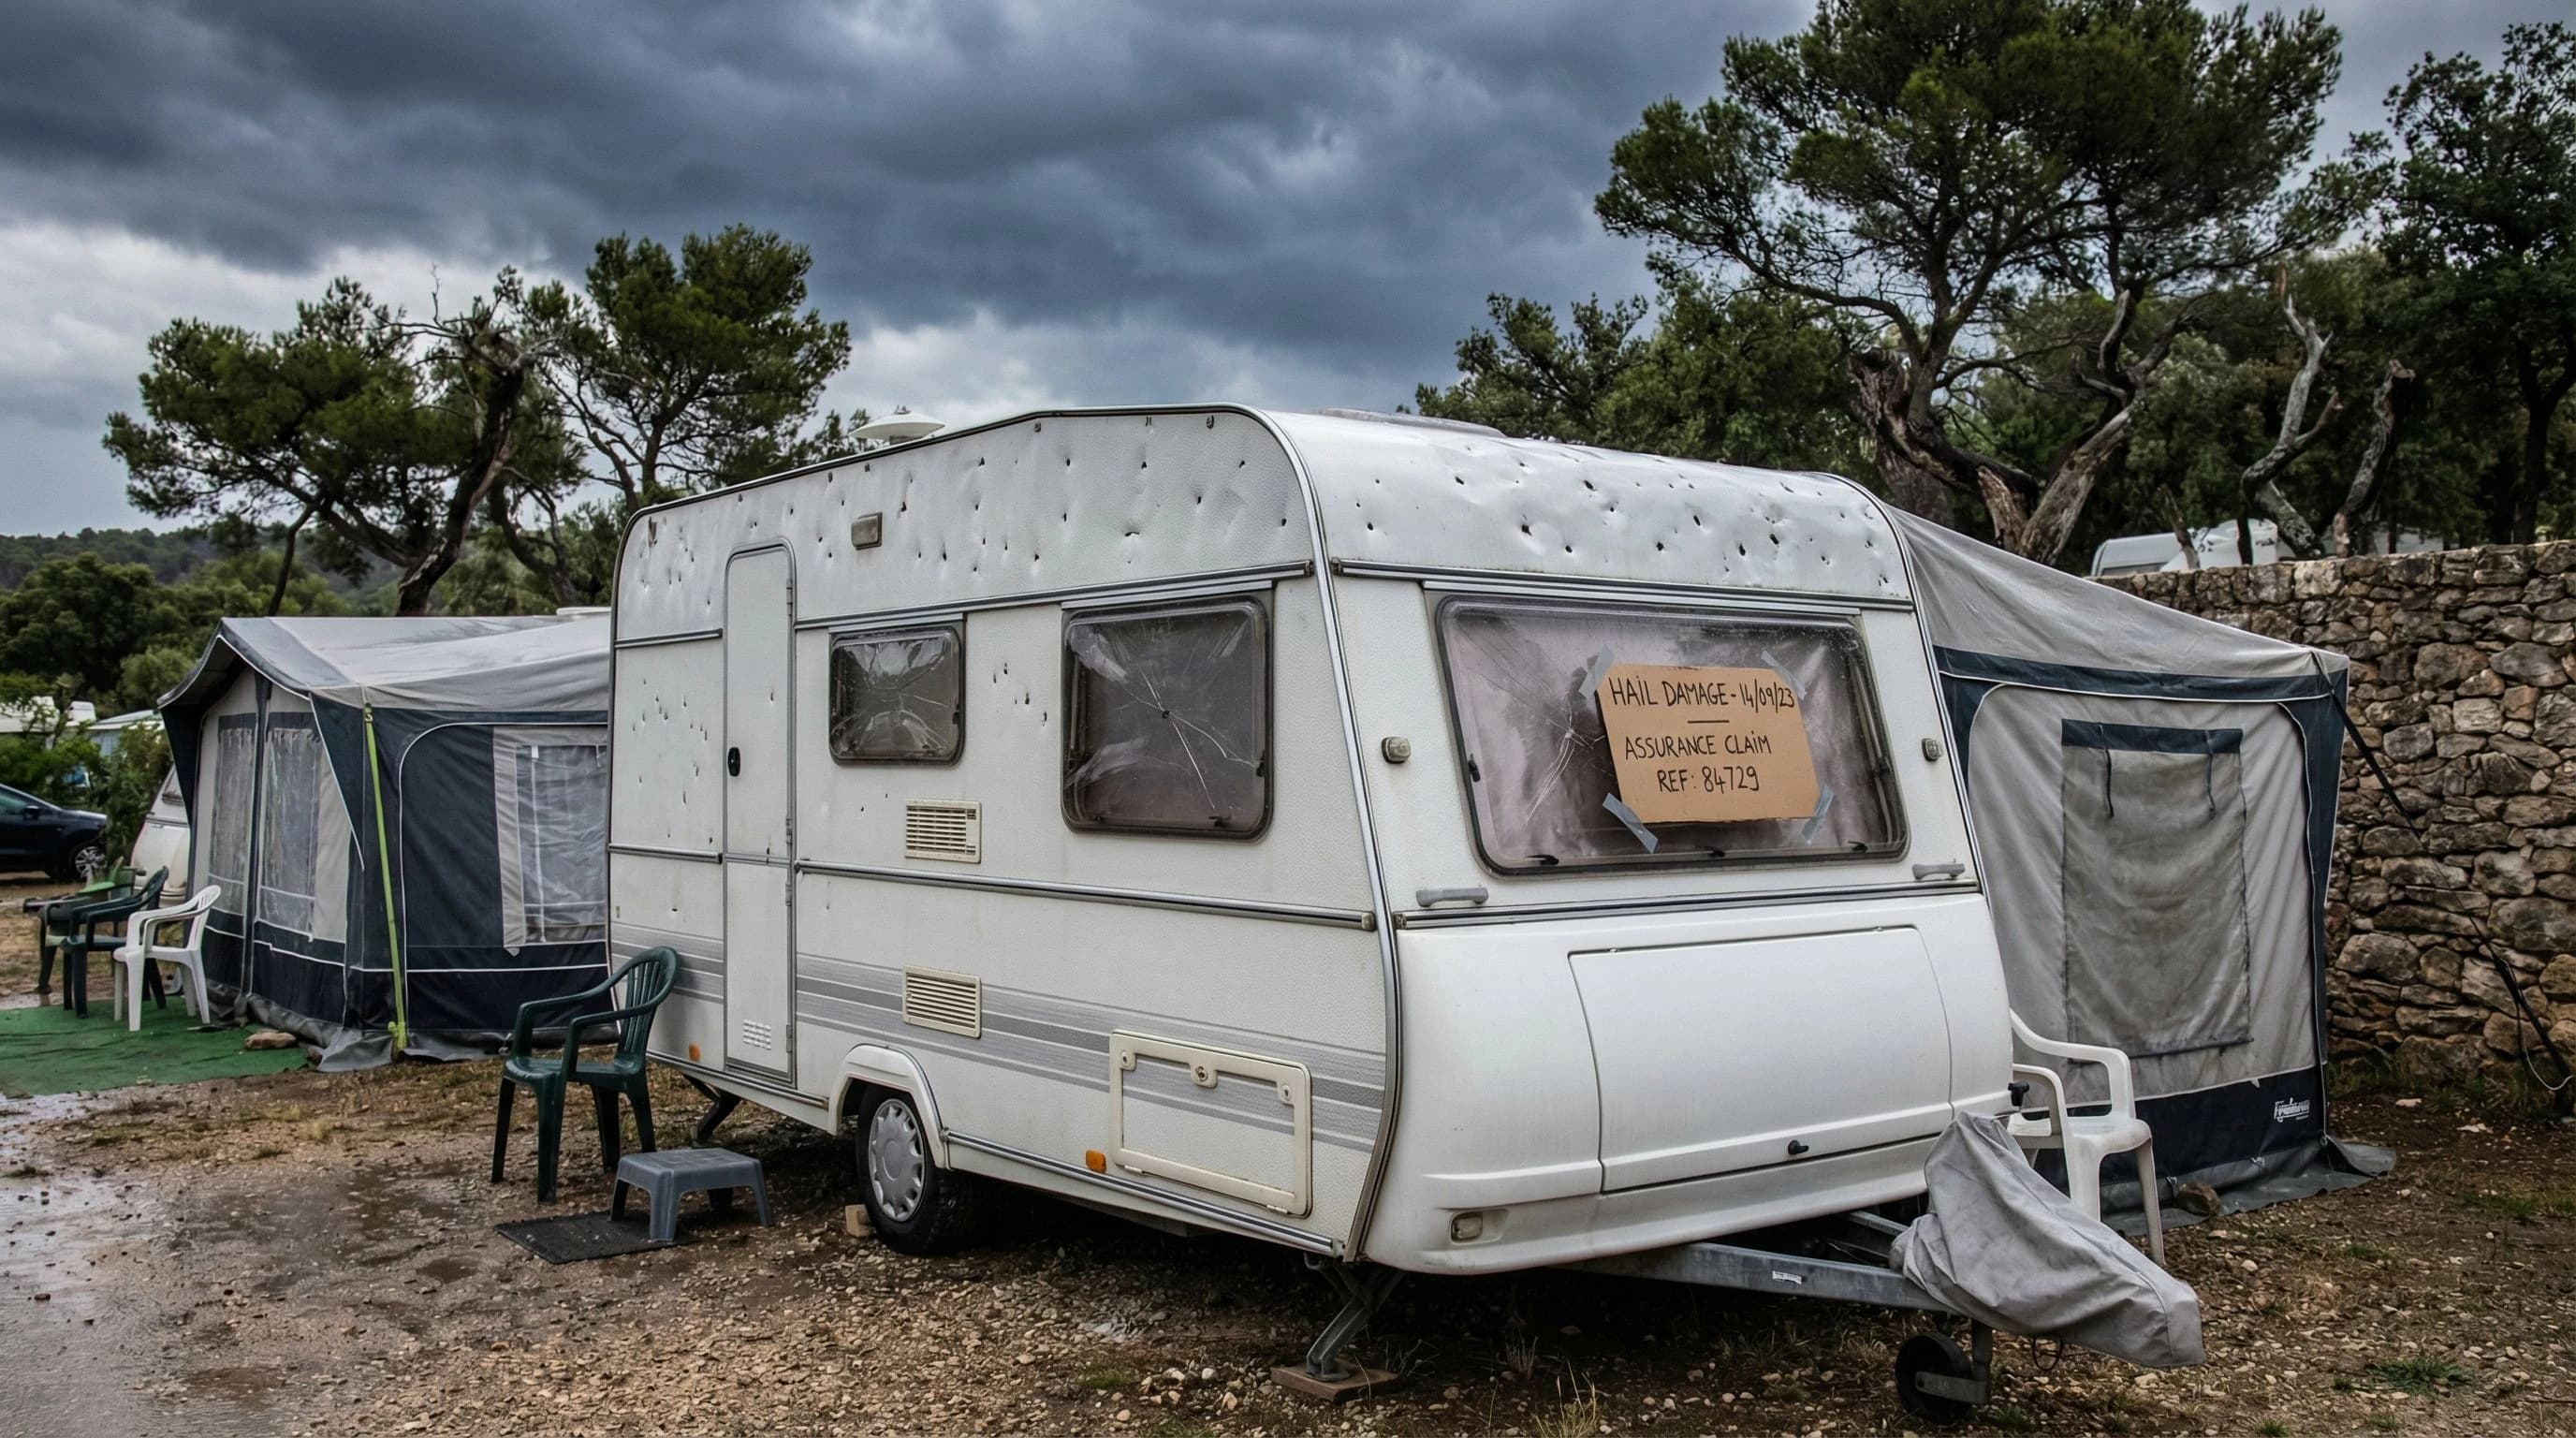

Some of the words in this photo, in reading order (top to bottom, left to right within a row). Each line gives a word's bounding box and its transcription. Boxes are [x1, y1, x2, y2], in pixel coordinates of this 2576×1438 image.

[1661, 680, 1730, 708] DAMAGE
[1739, 679, 1795, 713] 14/09/23
[1625, 734, 1717, 760] ASSURANCE
[1656, 769, 1697, 793] REF:
[1701, 766, 1760, 794] 84729
